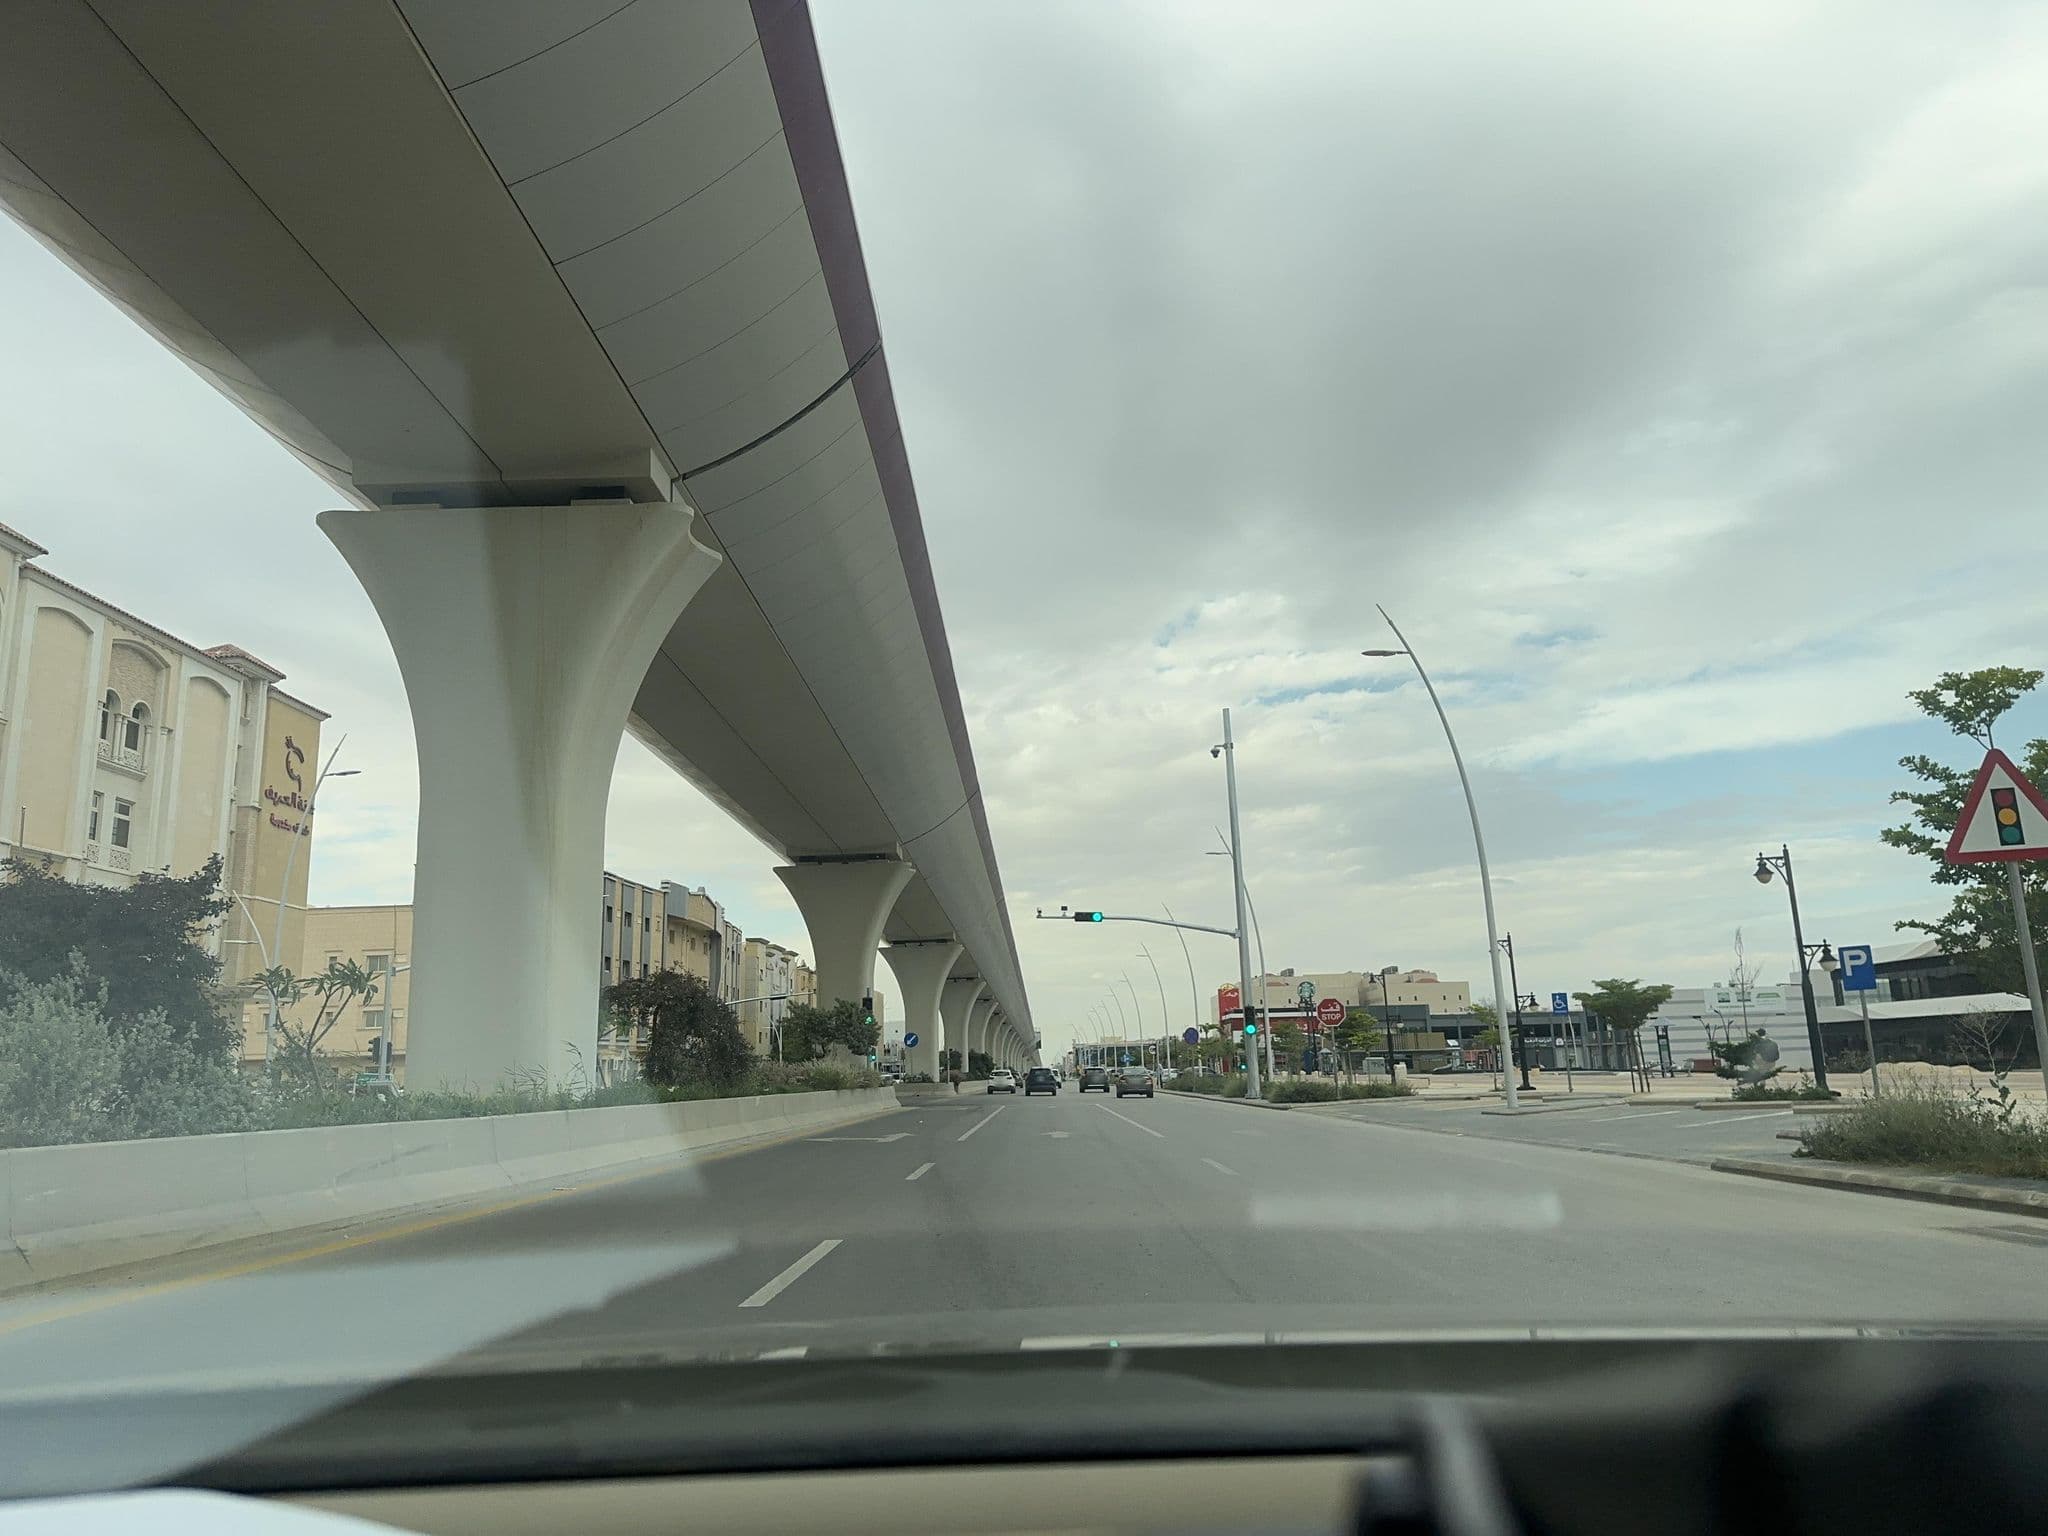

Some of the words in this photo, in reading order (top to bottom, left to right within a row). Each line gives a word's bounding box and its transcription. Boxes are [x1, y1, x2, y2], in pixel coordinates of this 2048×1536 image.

[1843, 949, 1867, 976] P
[1320, 1002, 1341, 1012] قف
[1321, 1013, 1341, 1021] STOP
